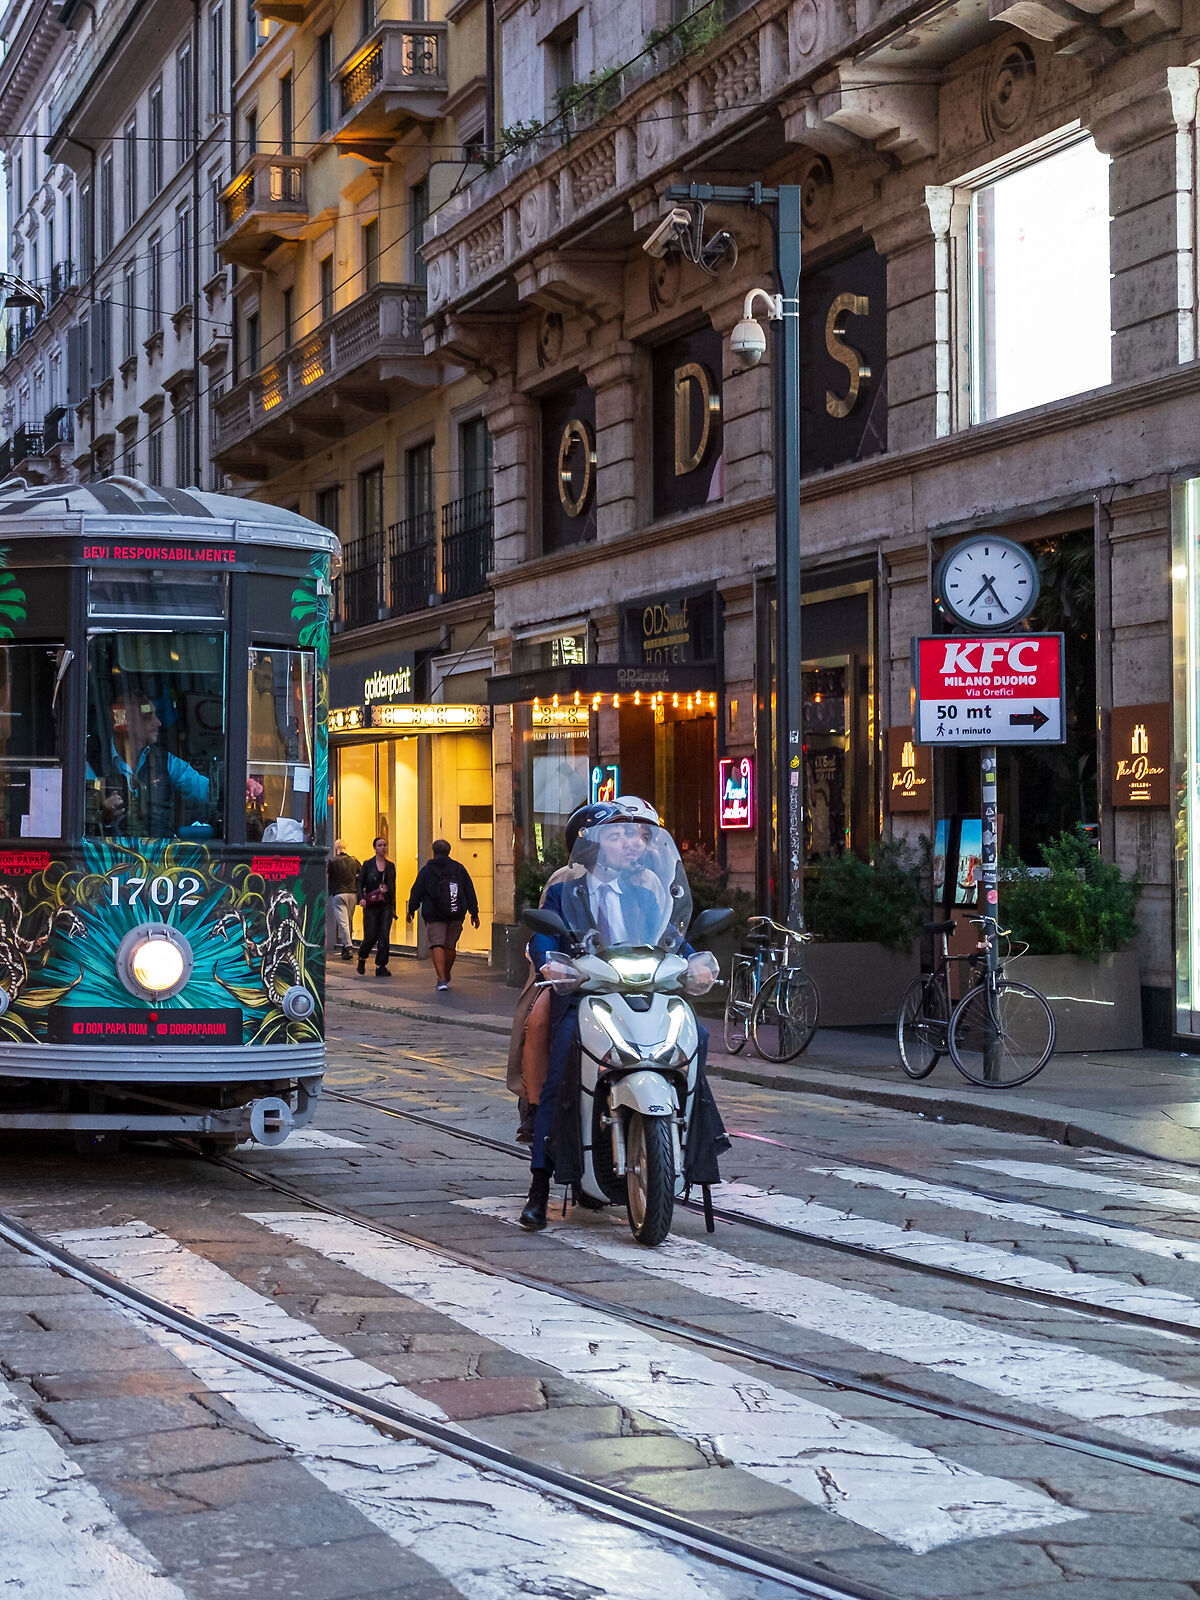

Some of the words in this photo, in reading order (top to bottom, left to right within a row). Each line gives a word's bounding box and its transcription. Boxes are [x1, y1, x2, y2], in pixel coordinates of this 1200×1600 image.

[83, 546, 110, 559] BEVI
[114, 547, 236, 562] RESPONSABILMENTE
[646, 645, 686, 664] HOTEL
[939, 641, 1039, 674] KFC
[365, 666, 411, 705] goldenpoint
[944, 676, 991, 687] MILANO
[993, 675, 1037, 686] DUOMO
[965, 688, 980, 697] Via
[983, 688, 1014, 696] Orefici
[937, 705, 958, 719] 50
[966, 705, 992, 719] mt
[962, 727, 992, 735] minuto
[1116, 760, 1133, 780] The
[17, 856, 40, 864] PAPA
[110, 876, 200, 906] 1702
[86, 1022, 104, 1034] DON
[105, 1022, 127, 1034] PAPA
[128, 1023, 148, 1035] RUM
[170, 1023, 227, 1035] DONPAPARUM
